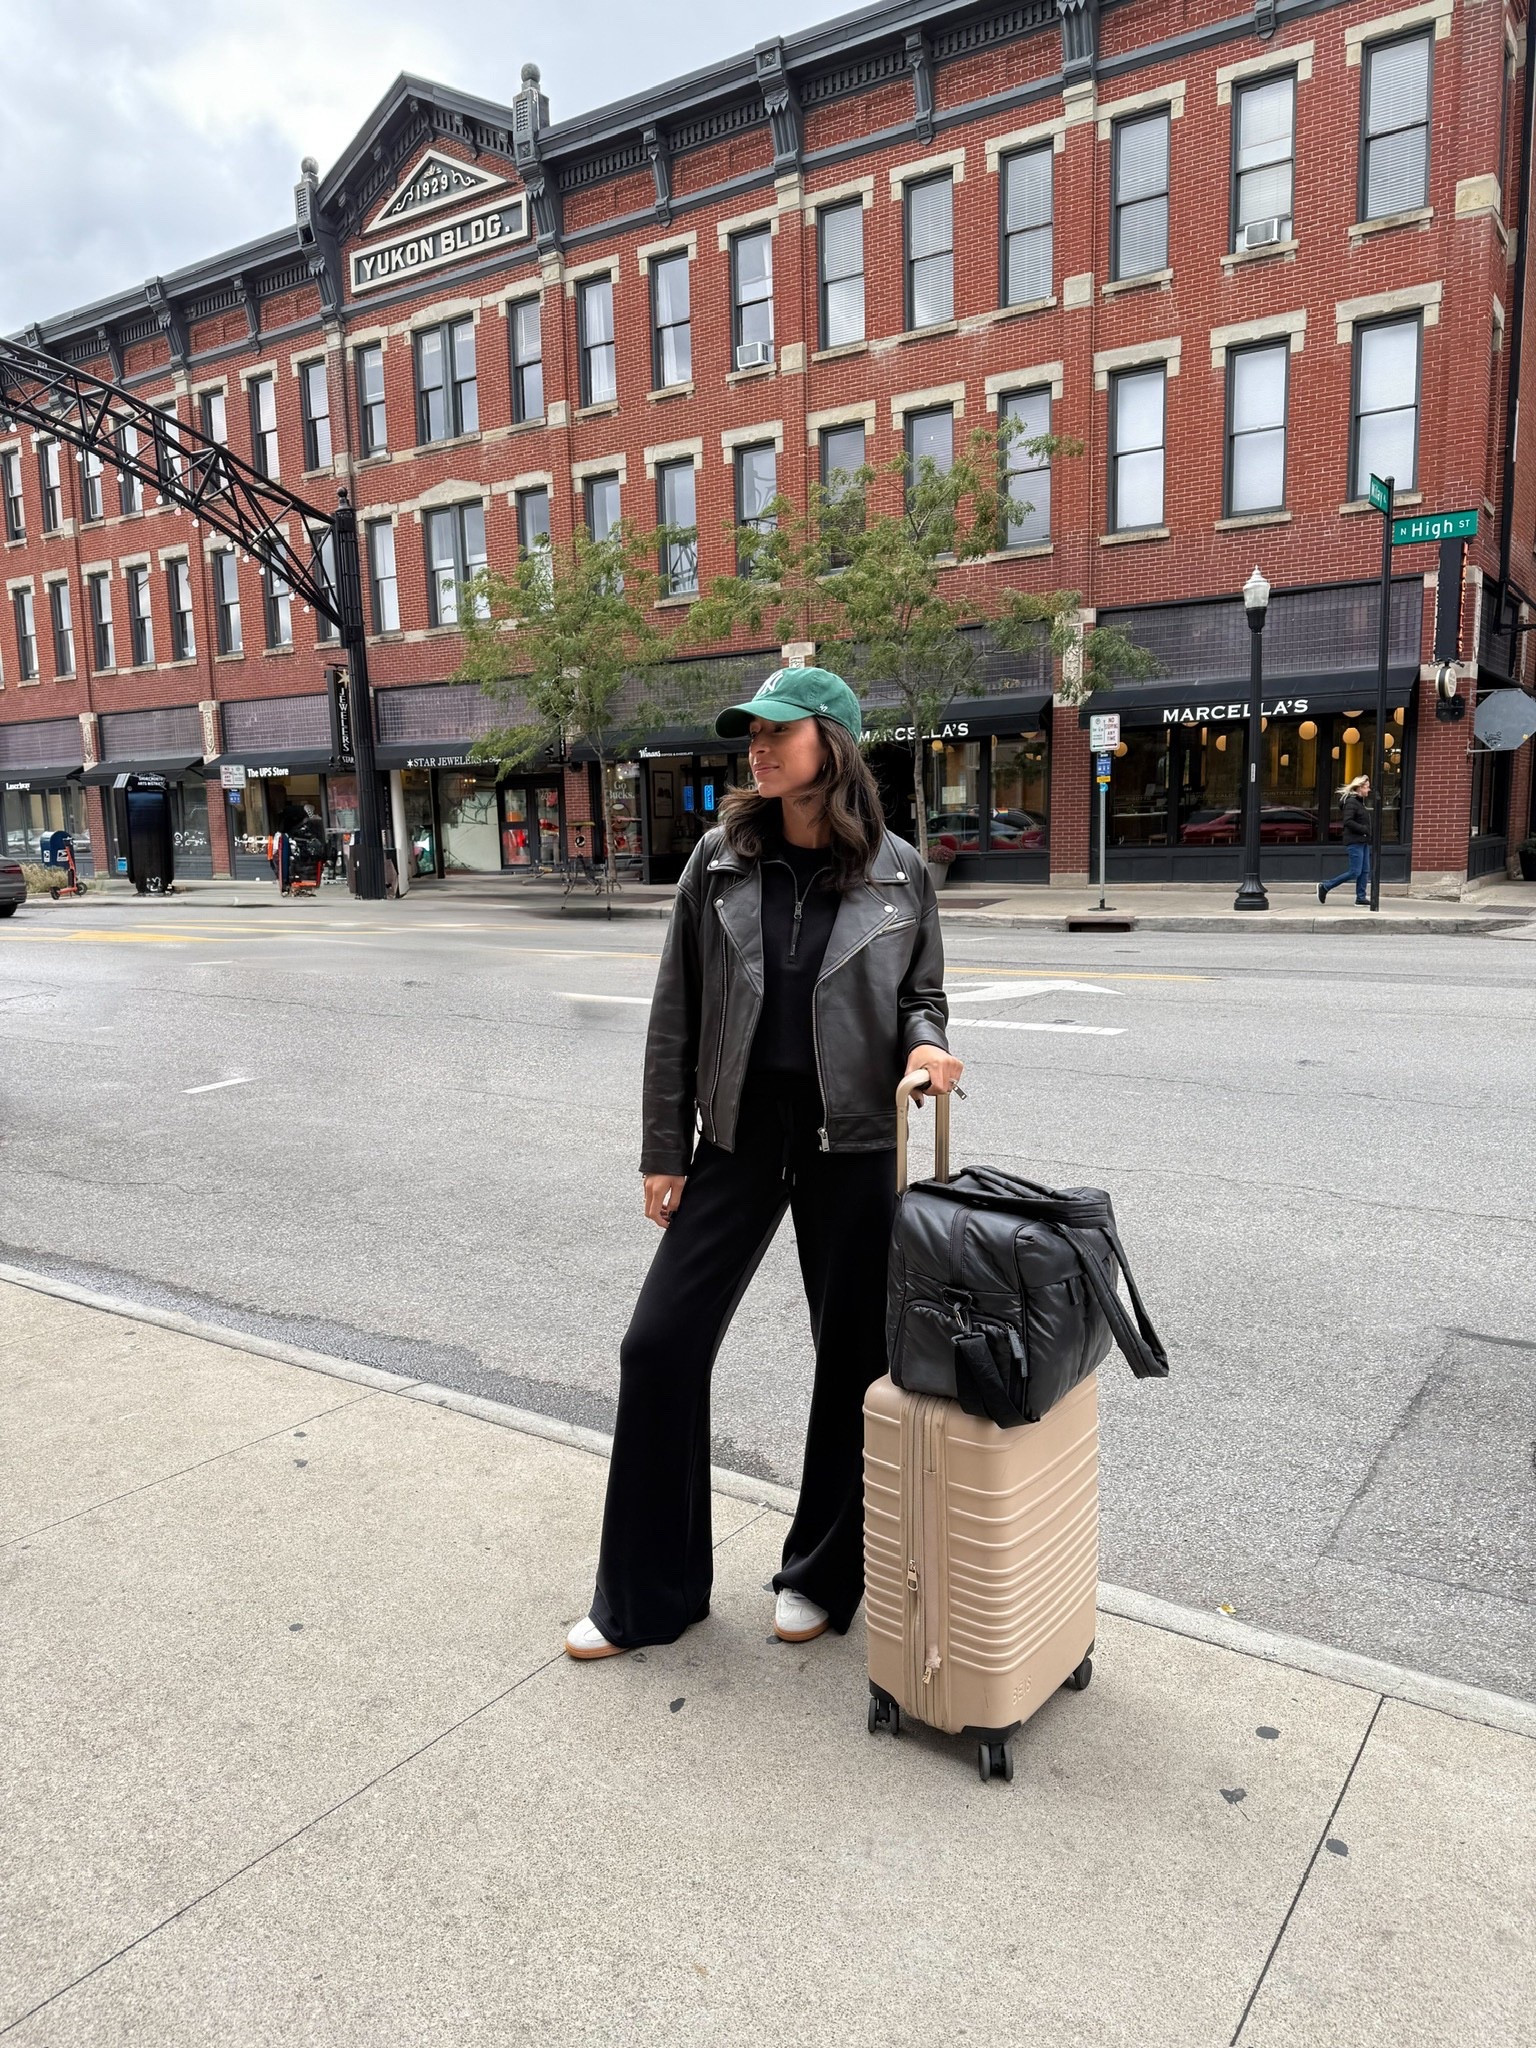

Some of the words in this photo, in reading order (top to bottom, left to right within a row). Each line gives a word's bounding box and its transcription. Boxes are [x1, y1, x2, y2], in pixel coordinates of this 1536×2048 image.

[415, 176, 448, 200] 1929
[361, 238, 434, 280] YUKON
[441, 214, 511, 254] BLDG.
[1400, 527, 1407, 536] N
[1411, 519, 1453, 539] High
[1459, 519, 1471, 529] ST
[338, 687, 350, 752] JEWELERS
[1162, 699, 1309, 723] MARCELLA'S
[247, 768, 259, 778] The
[259, 767, 272, 777] UPS
[272, 766, 289, 777] Store
[413, 758, 436, 768] STAR
[437, 755, 482, 766] JEWELERS
[614, 781, 627, 791] Go
